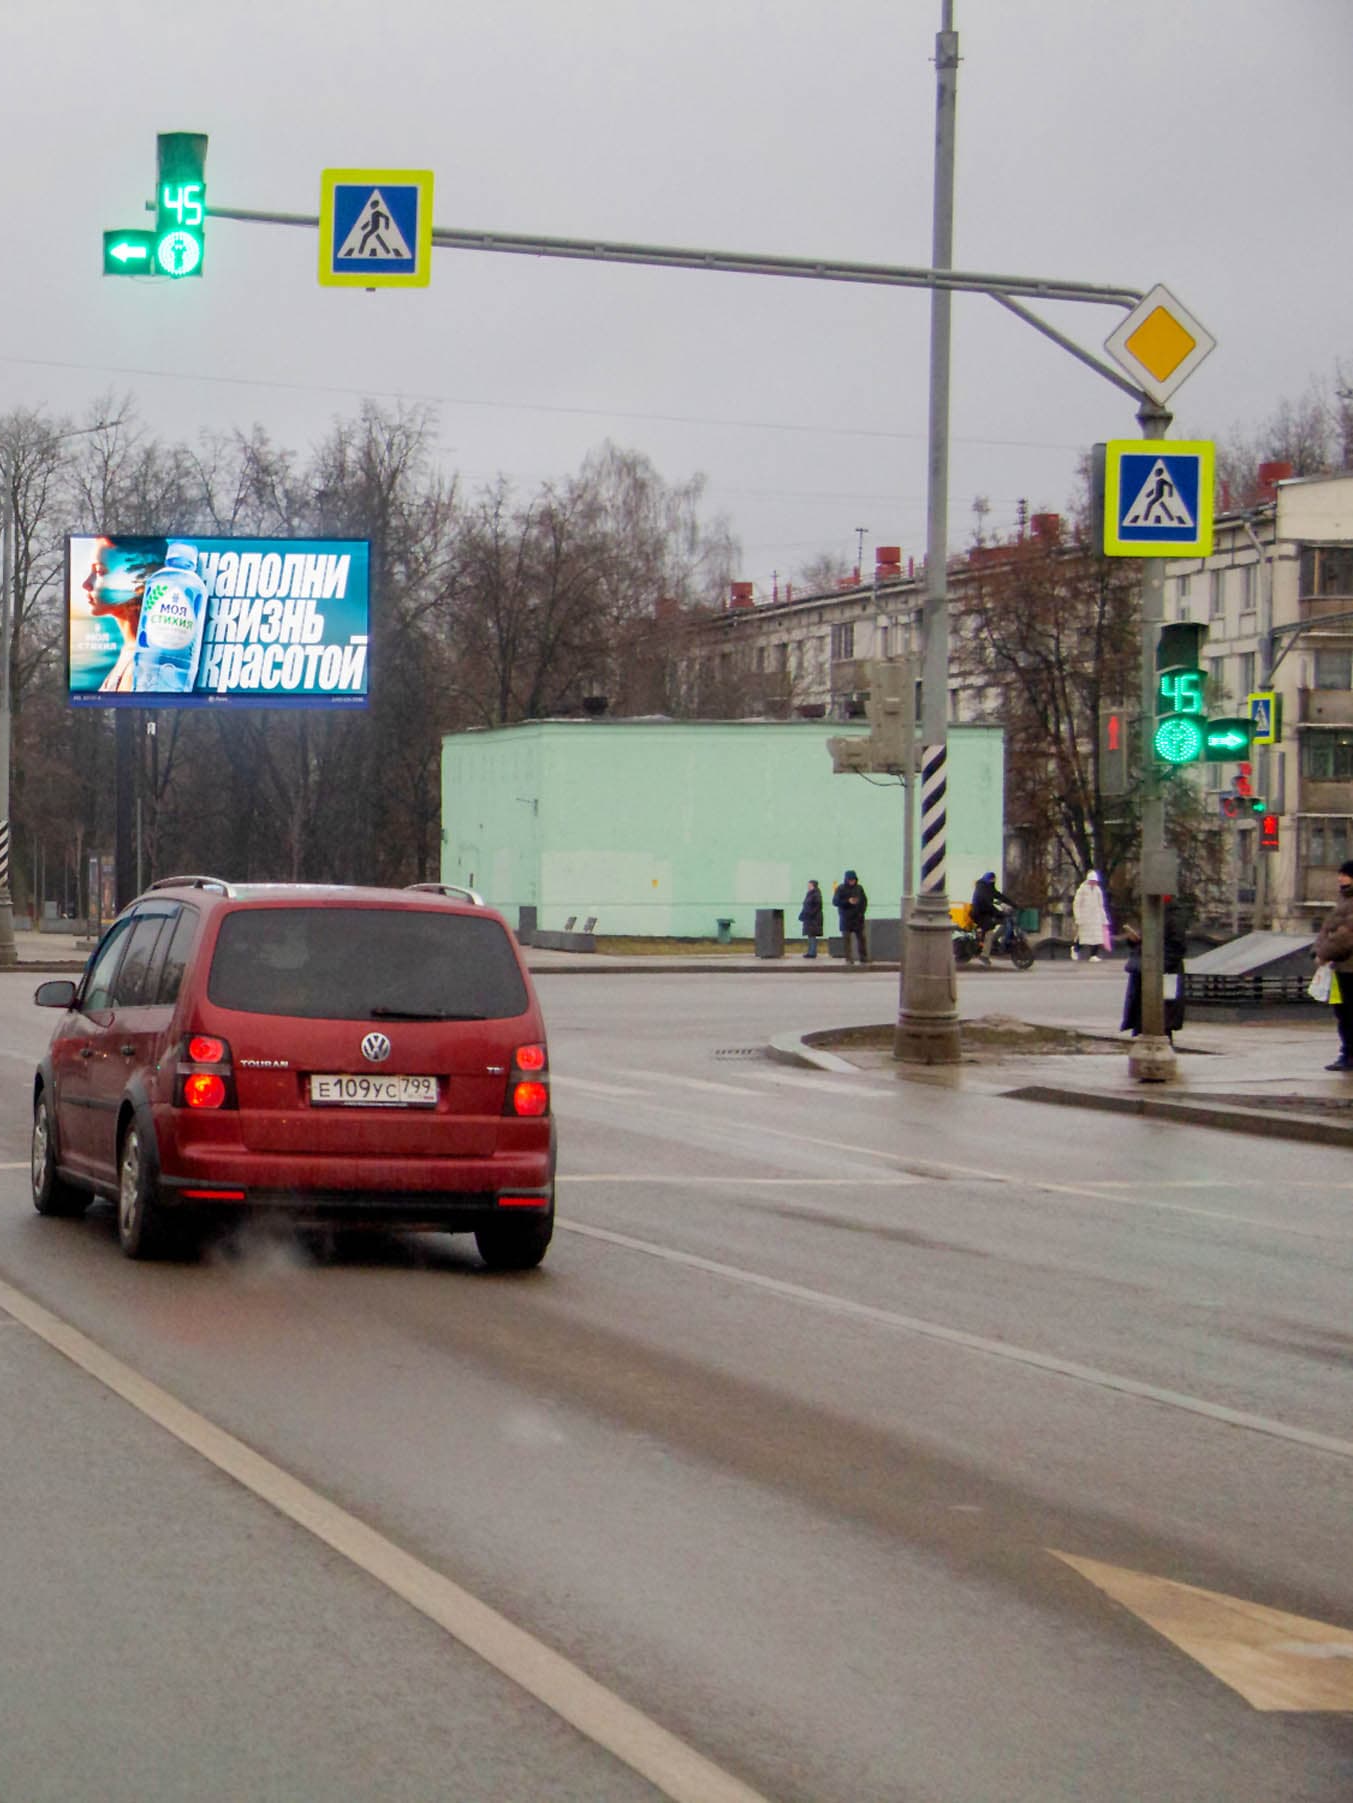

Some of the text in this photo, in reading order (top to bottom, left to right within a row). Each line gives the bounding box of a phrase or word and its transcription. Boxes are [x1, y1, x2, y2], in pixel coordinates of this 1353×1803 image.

[164, 185, 203, 226] 45
[204, 598, 325, 645] жизнь
[201, 635, 369, 693] красотой
[1161, 674, 1200, 713] 45
[240, 1059, 289, 1068] TOURAN
[400, 1078, 432, 1094] 799
